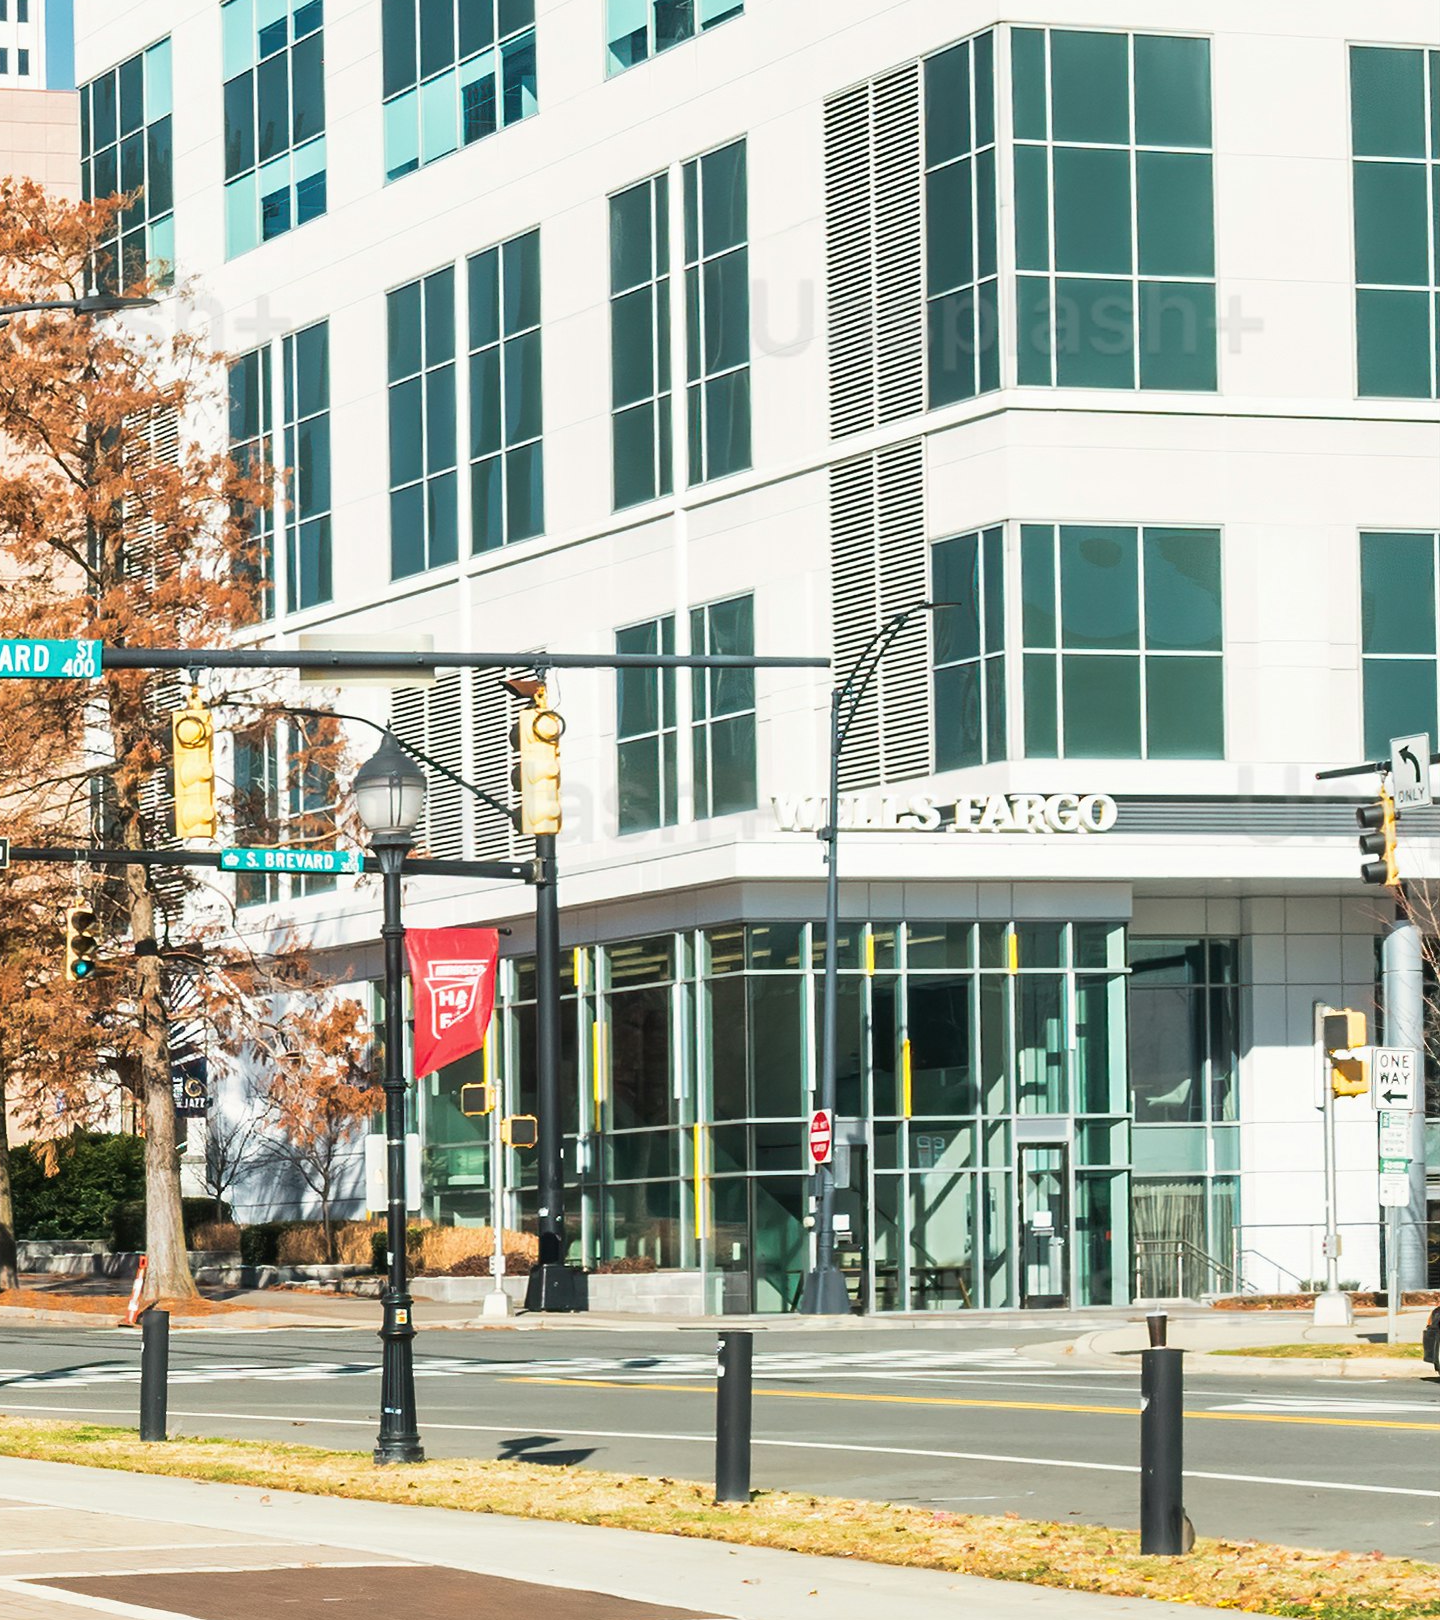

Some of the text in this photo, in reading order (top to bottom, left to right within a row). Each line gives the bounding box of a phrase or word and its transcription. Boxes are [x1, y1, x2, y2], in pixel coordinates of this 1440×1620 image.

[77, 641, 95, 660] ST
[61, 659, 95, 677] 400
[1399, 787, 1425, 802] ONLY
[770, 794, 941, 832] WELLS
[947, 793, 1118, 833] FARGO
[246, 852, 334, 869] S. BREVARD
[1380, 1054, 1410, 1069] ONE
[1380, 1072, 1411, 1085] WAY
[184, 1098, 206, 1108] JAZZ
